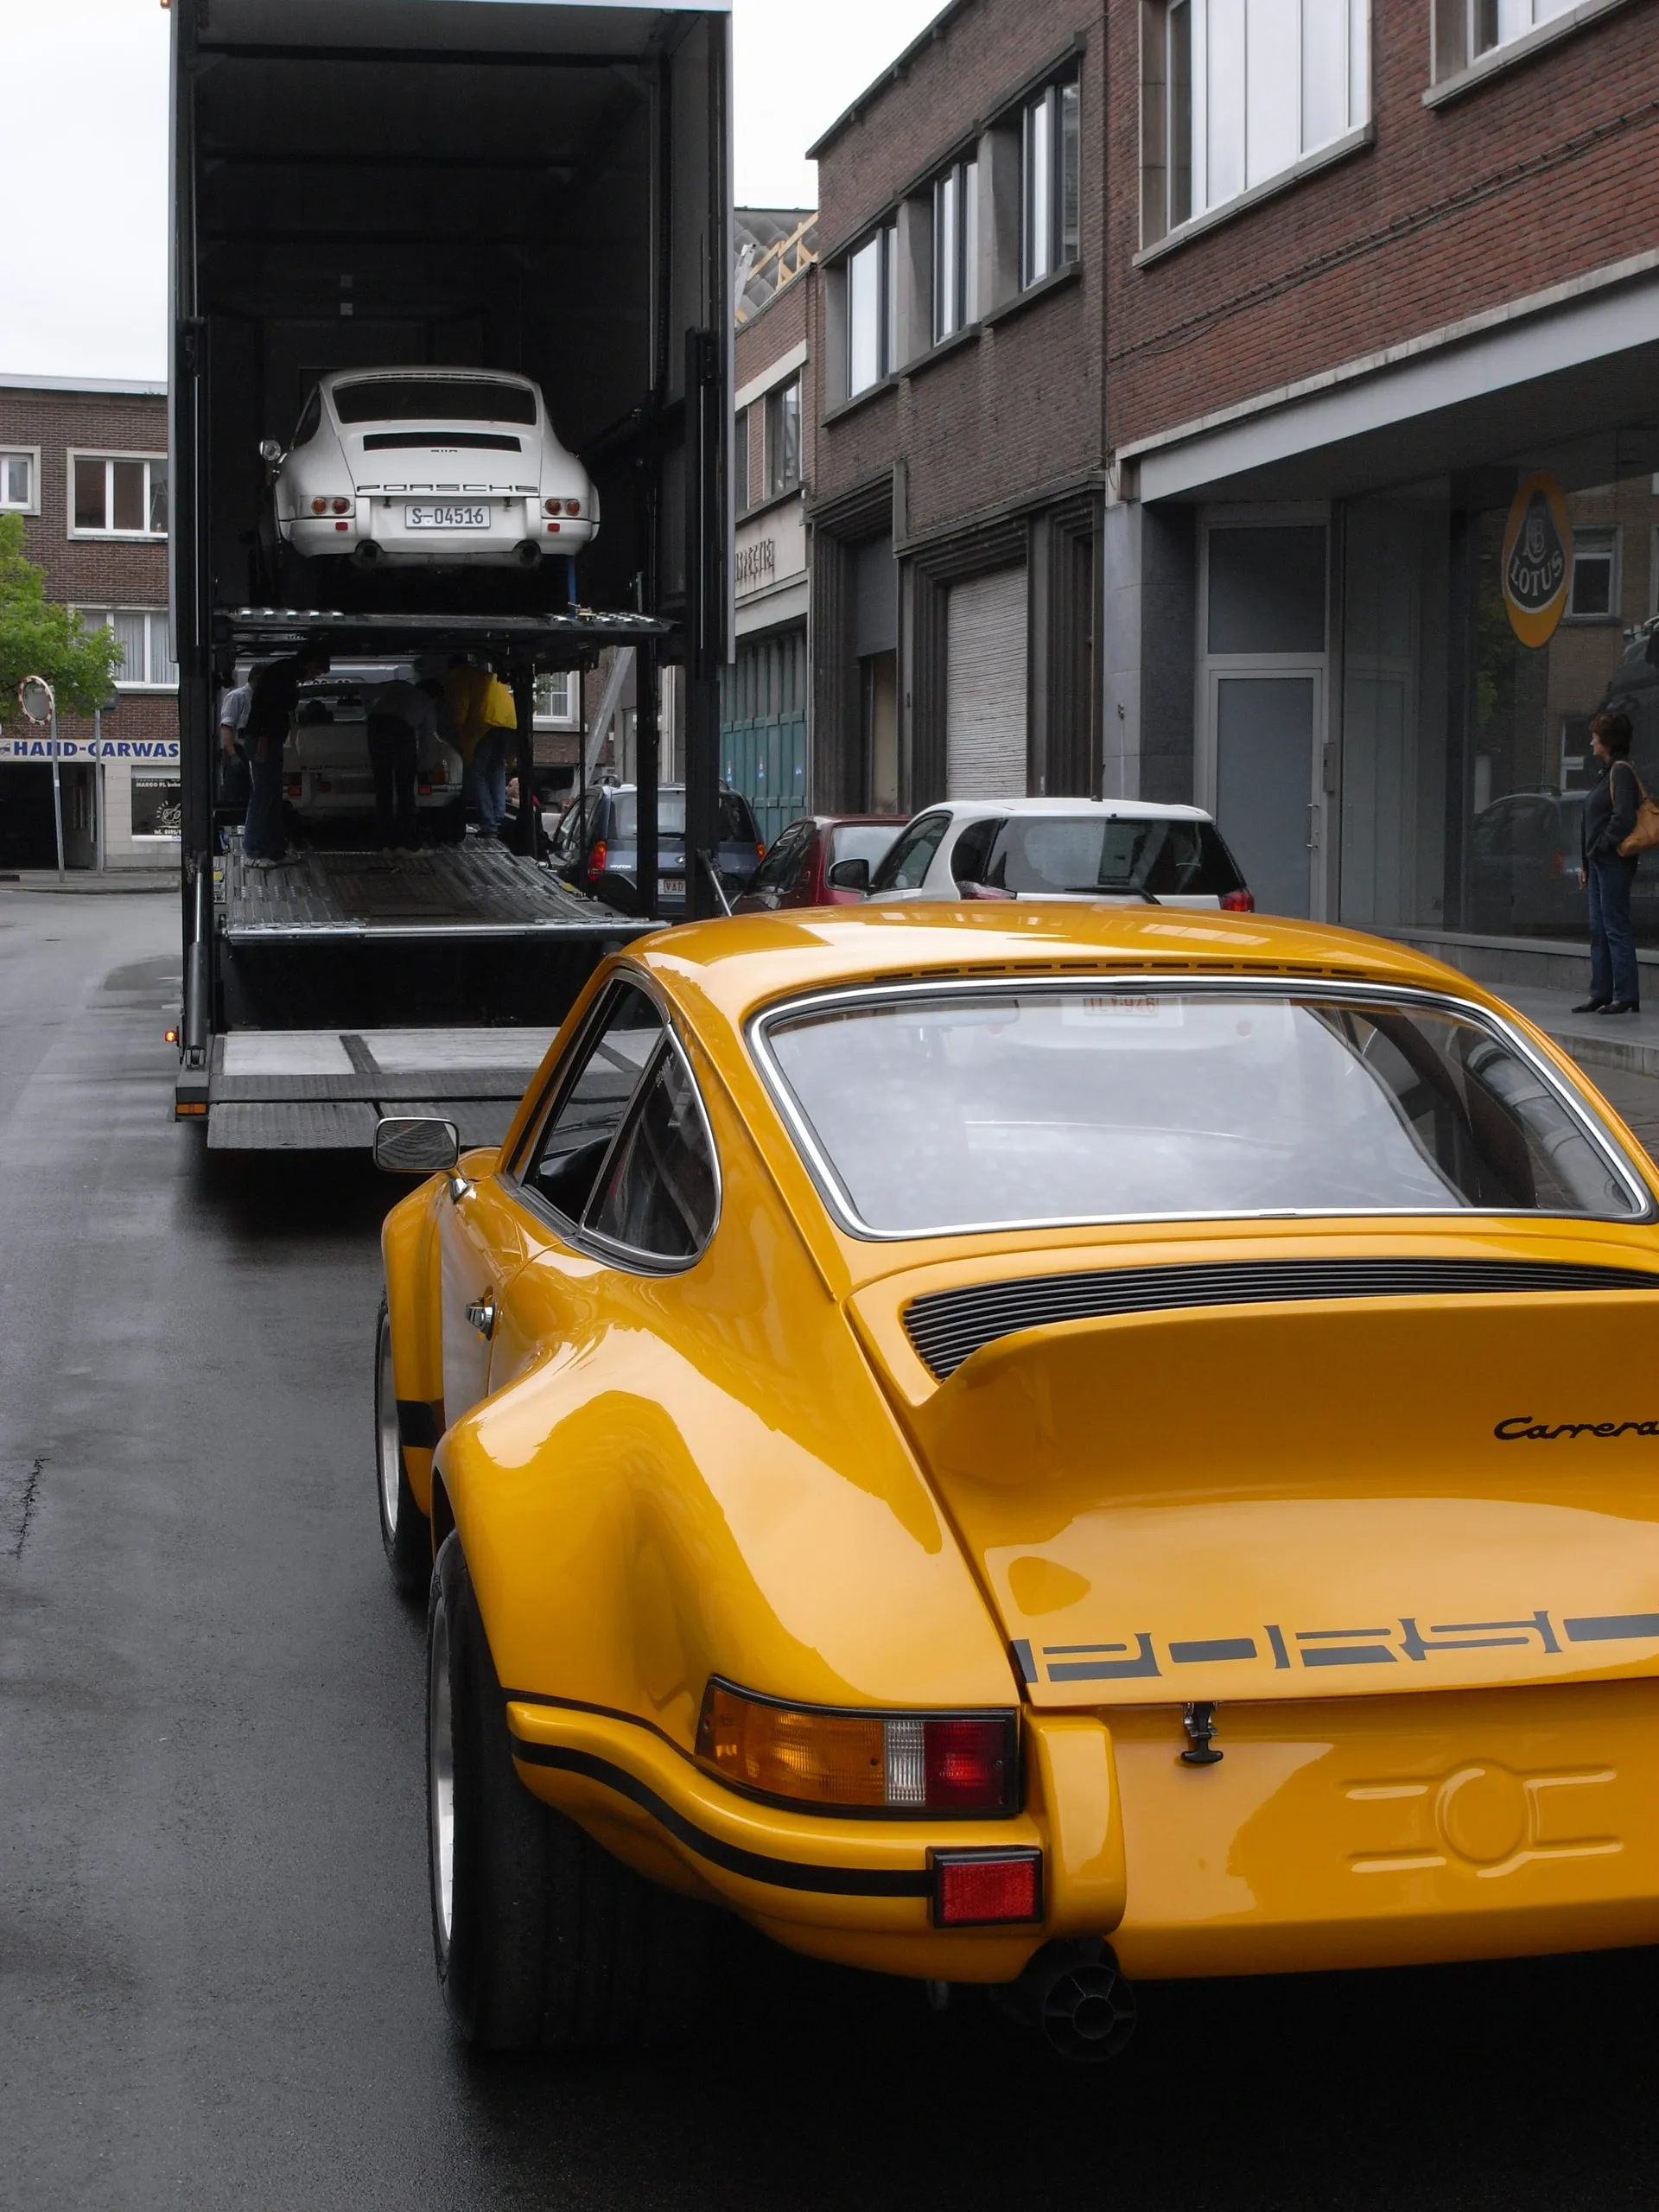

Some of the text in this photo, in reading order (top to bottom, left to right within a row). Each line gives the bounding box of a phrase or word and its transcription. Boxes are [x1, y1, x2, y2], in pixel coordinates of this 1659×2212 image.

[357, 484, 539, 493] PORSCHE
[411, 507, 485, 525] S-04516
[1510, 550, 1563, 596] LOTUS
[1494, 1415, 1659, 1440] Carrera
